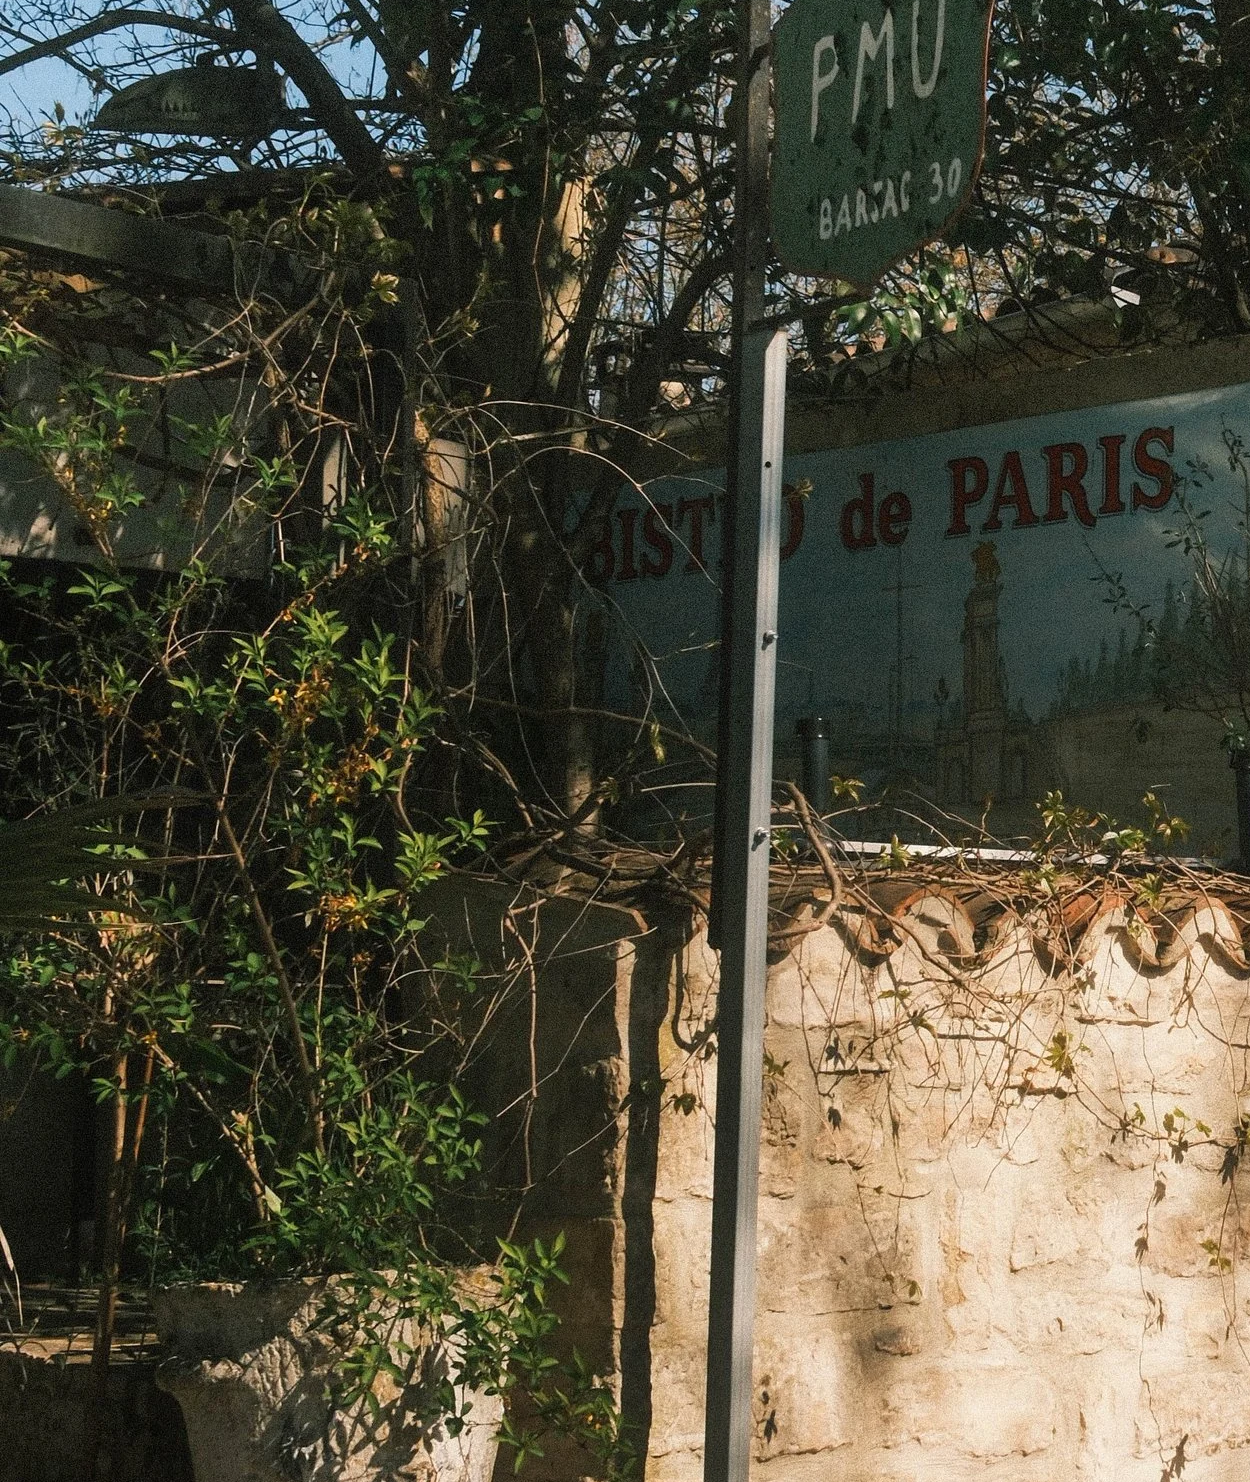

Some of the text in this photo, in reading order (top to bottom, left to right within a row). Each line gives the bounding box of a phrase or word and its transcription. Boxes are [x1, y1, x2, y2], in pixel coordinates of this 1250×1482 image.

[929, 157, 962, 205] 30
[839, 472, 912, 550] de
[945, 426, 1174, 539] PARIS
